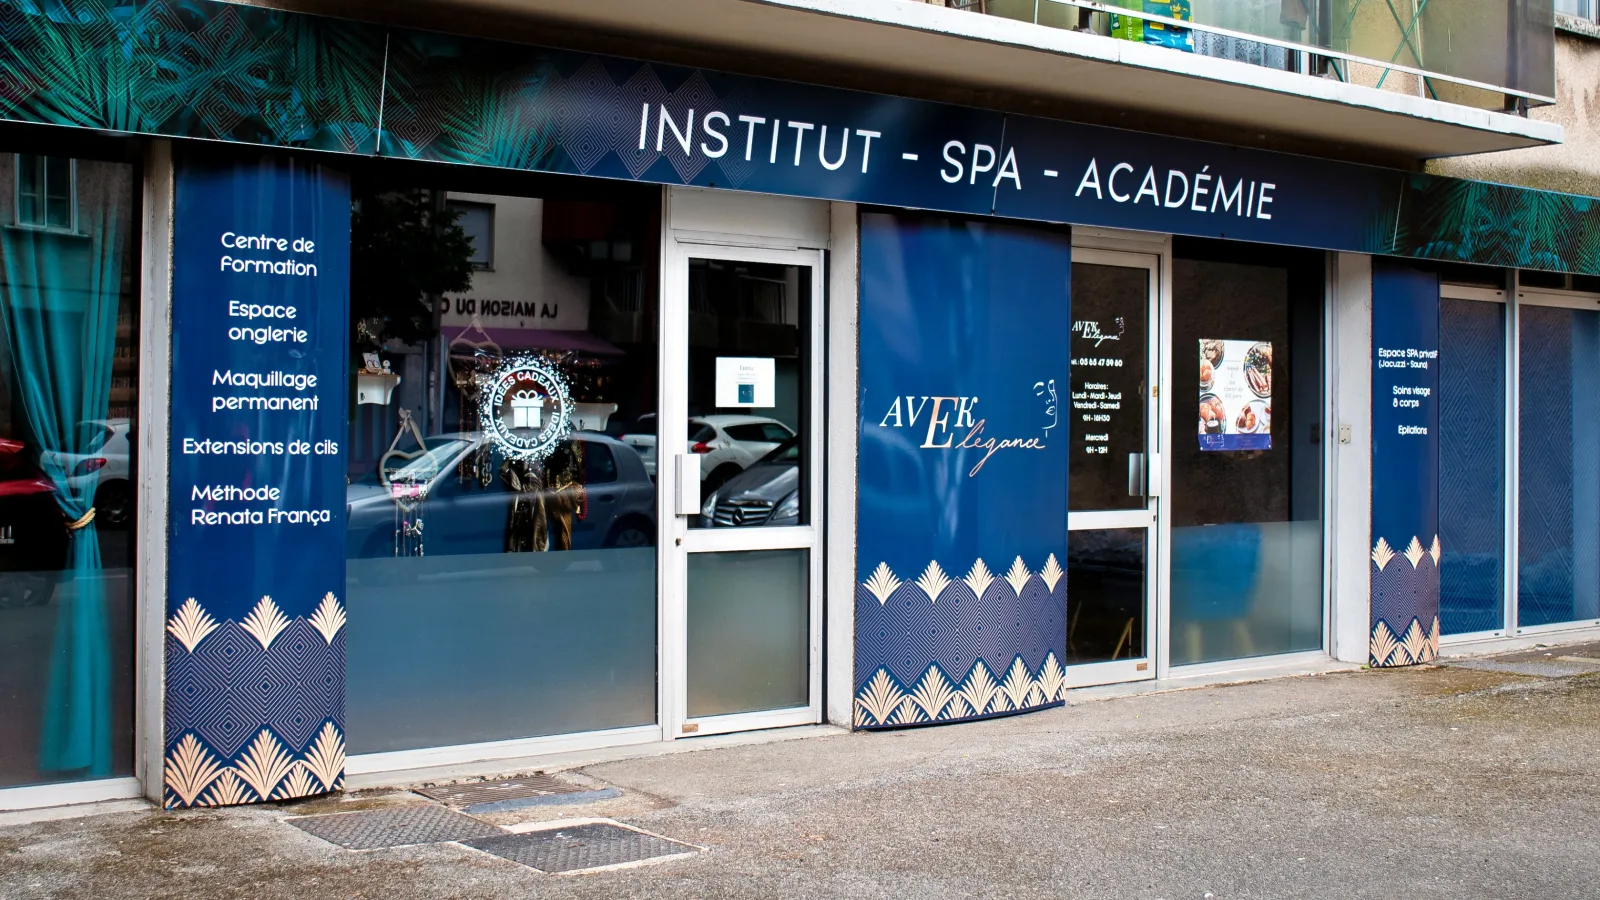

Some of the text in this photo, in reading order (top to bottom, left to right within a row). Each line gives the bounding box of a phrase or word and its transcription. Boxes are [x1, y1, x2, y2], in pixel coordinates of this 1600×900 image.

[638, 102, 1277, 220] INSTITUT - SPA - ACADÉMIE
[221, 231, 315, 253] Centre de
[229, 300, 297, 320] Espace
[228, 326, 308, 345] onglerie
[1071, 320, 1099, 339] AVEK
[1080, 357, 1088, 366] 05
[1098, 358, 1106, 366] 47
[1378, 347, 1438, 360] Espace SPA privatif
[212, 369, 317, 391] Maquillage
[516, 371, 560, 404] CADEAUX
[1072, 391, 1087, 400] Lundi
[1090, 392, 1105, 400] Mardi
[1107, 392, 1122, 400] Jeudi
[1392, 385, 1431, 397] Soins visage
[212, 394, 319, 413] permanent
[1073, 401, 1097, 409] Vendredi
[1100, 401, 1121, 410] Samedi
[1398, 398, 1420, 409] corps
[879, 395, 979, 449] AVEK
[1398, 424, 1428, 436] Epilations
[495, 416, 538, 448] CADEAUX
[1085, 433, 1109, 441] Mercredi
[183, 437, 338, 455] Extensions de cils
[191, 484, 280, 501] Méthode
[191, 508, 331, 527] Renata França
